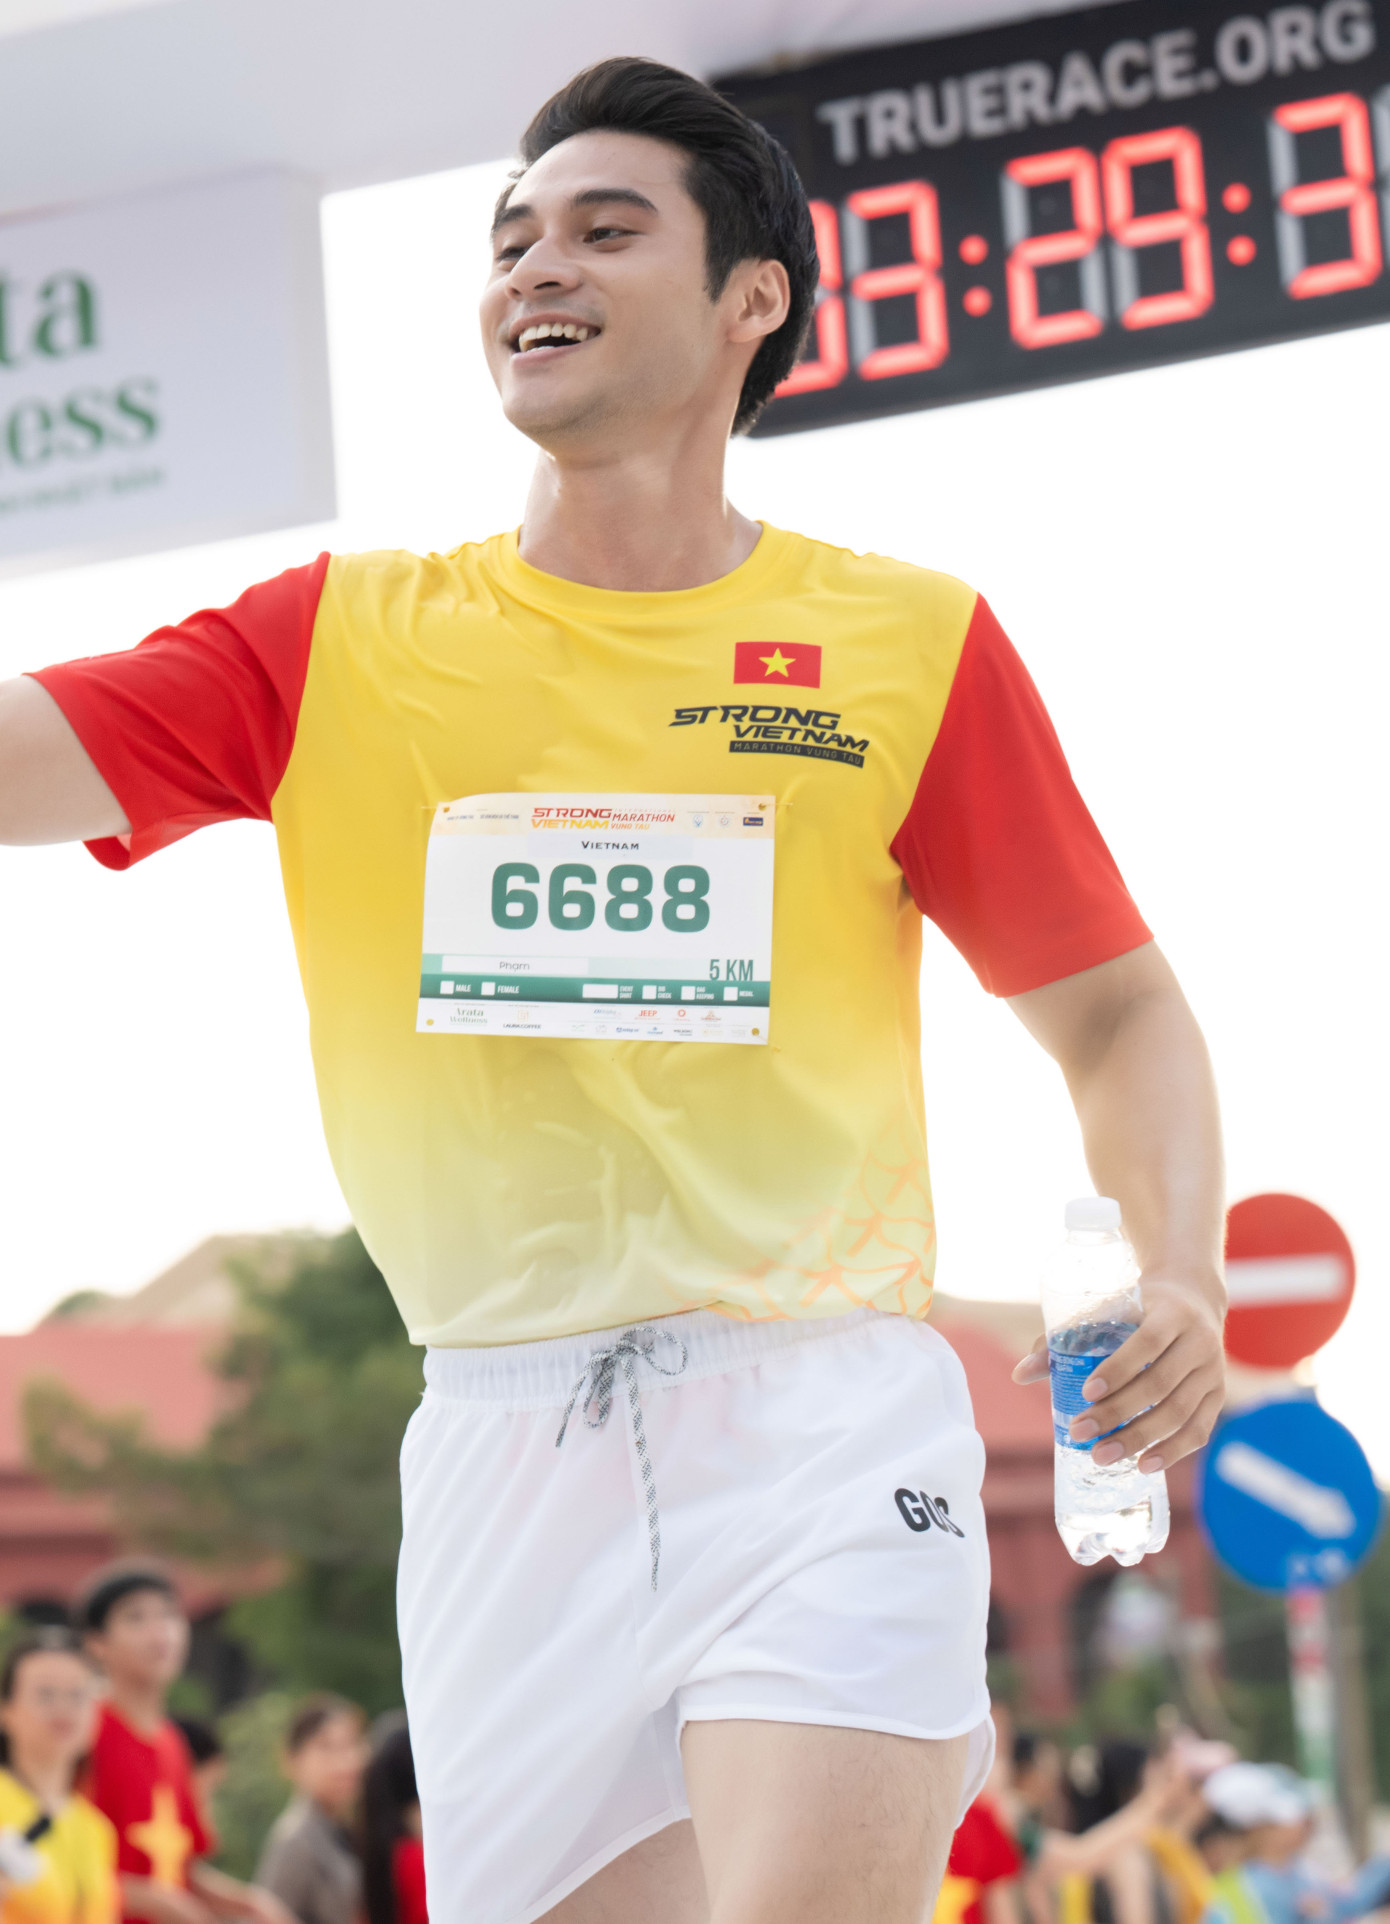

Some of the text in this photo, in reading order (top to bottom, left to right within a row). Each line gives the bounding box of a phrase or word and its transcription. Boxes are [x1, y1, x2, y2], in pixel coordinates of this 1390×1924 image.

[817, 0, 1375, 164] TRUERACE.ORG
[668, 705, 841, 730] STRONG
[733, 725, 870, 752] VIETNAM
[734, 742, 862, 765] MARATHON VUNG TAU
[531, 819, 609, 829] VIETNAM
[532, 808, 612, 818] STRONG
[612, 813, 675, 822] MARATHON
[491, 862, 710, 933] 6688
[709, 959, 753, 981] 5 KM
[455, 984, 471, 993] MALE
[497, 985, 520, 994] FEMALE
